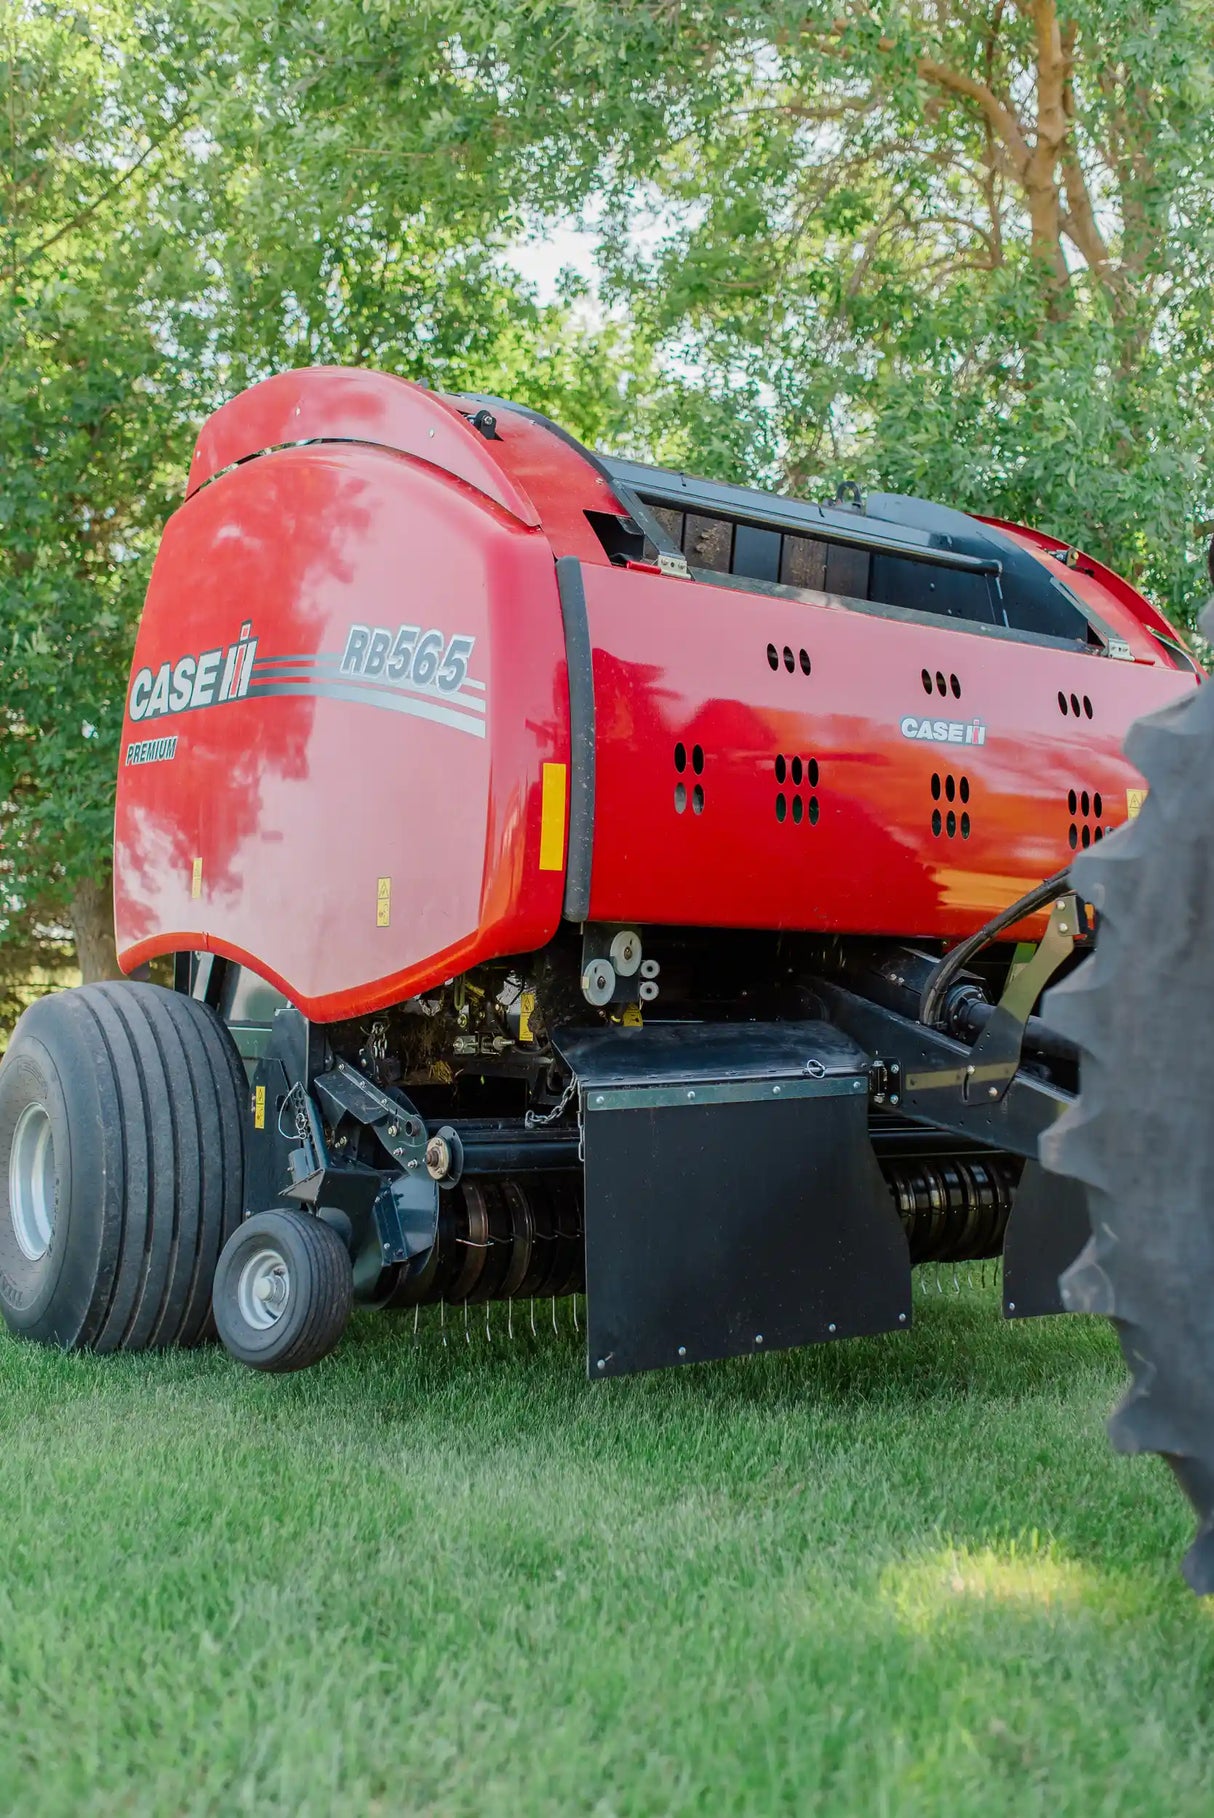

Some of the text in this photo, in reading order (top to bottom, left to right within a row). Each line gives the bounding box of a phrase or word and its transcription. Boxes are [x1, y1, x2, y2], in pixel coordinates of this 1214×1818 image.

[340, 624, 476, 694] RB565
[129, 651, 222, 721] CASE
[126, 736, 177, 766] PREMIUM
[901, 718, 964, 742] CASE
